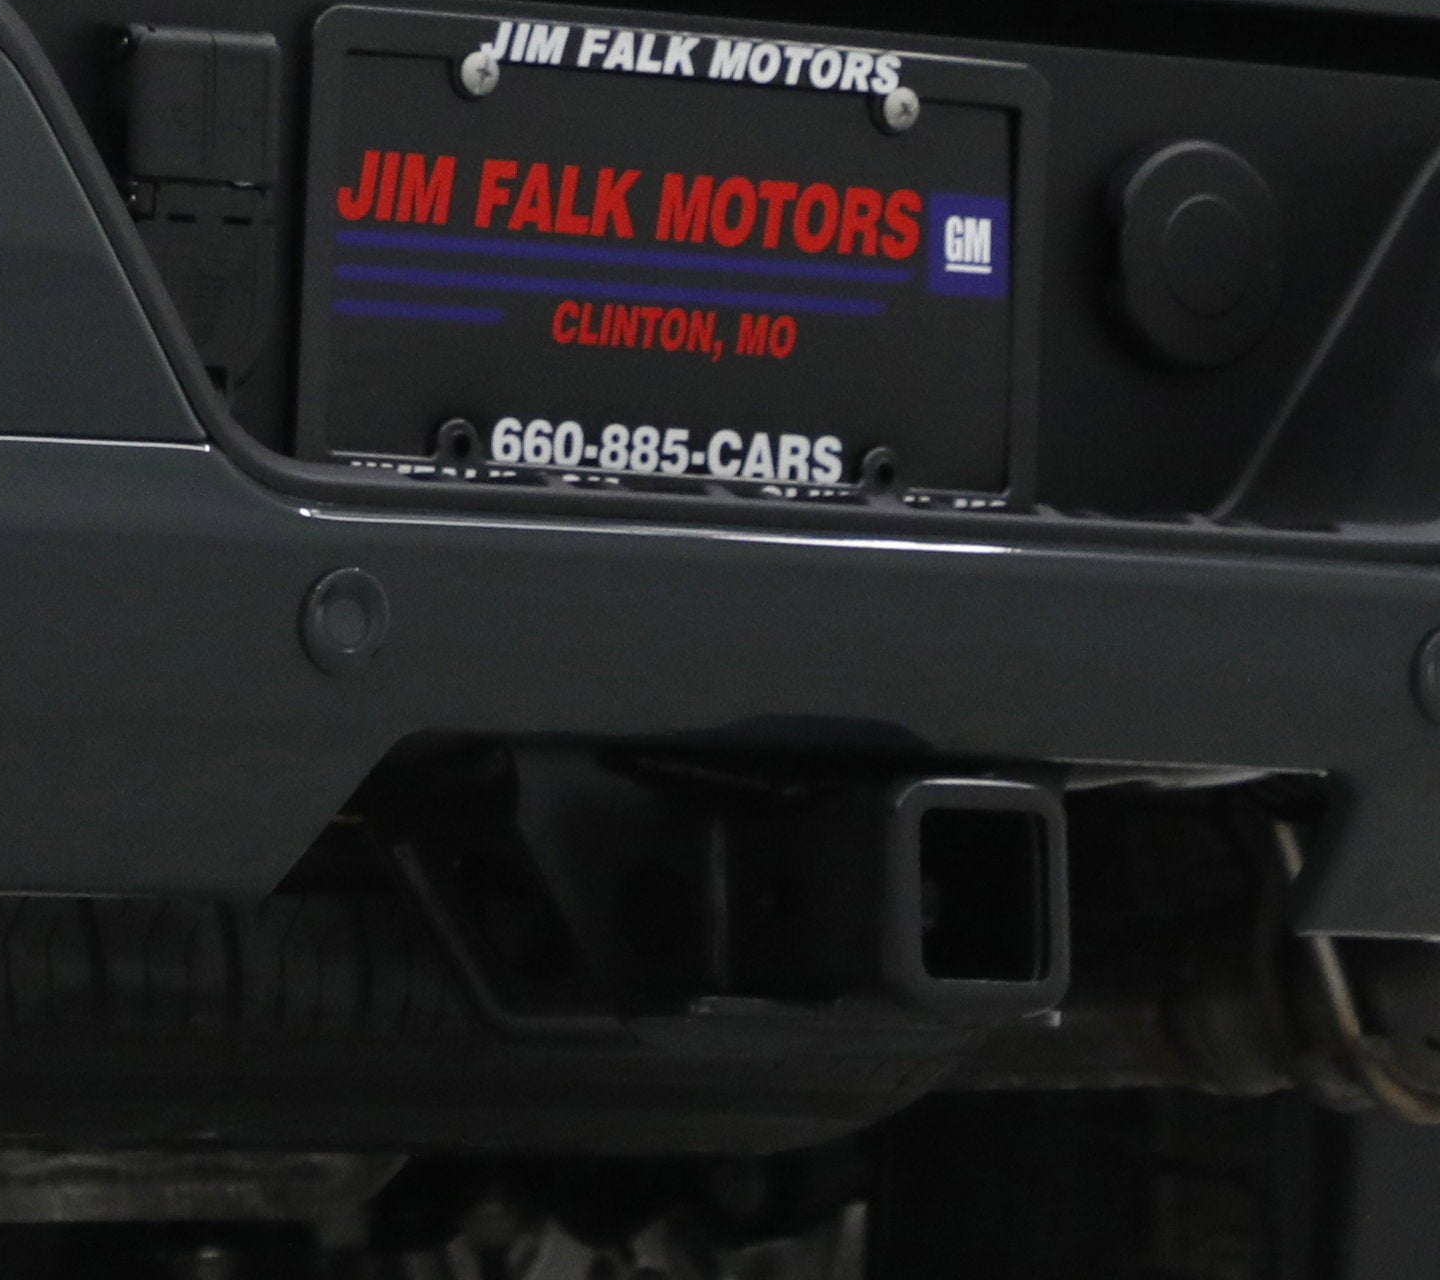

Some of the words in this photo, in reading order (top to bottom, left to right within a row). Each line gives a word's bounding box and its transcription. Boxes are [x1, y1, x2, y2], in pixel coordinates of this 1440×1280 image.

[481, 21, 569, 65] JIM
[577, 28, 700, 77] FALK
[708, 40, 902, 95] MOTORS
[337, 150, 456, 225] JIM
[474, 159, 641, 238] FALK
[655, 172, 921, 259] MOTORS
[944, 215, 992, 264] GM
[552, 299, 722, 362] CLINTON,
[736, 313, 797, 359] MO
[491, 416, 844, 485] 660-885-CARS
